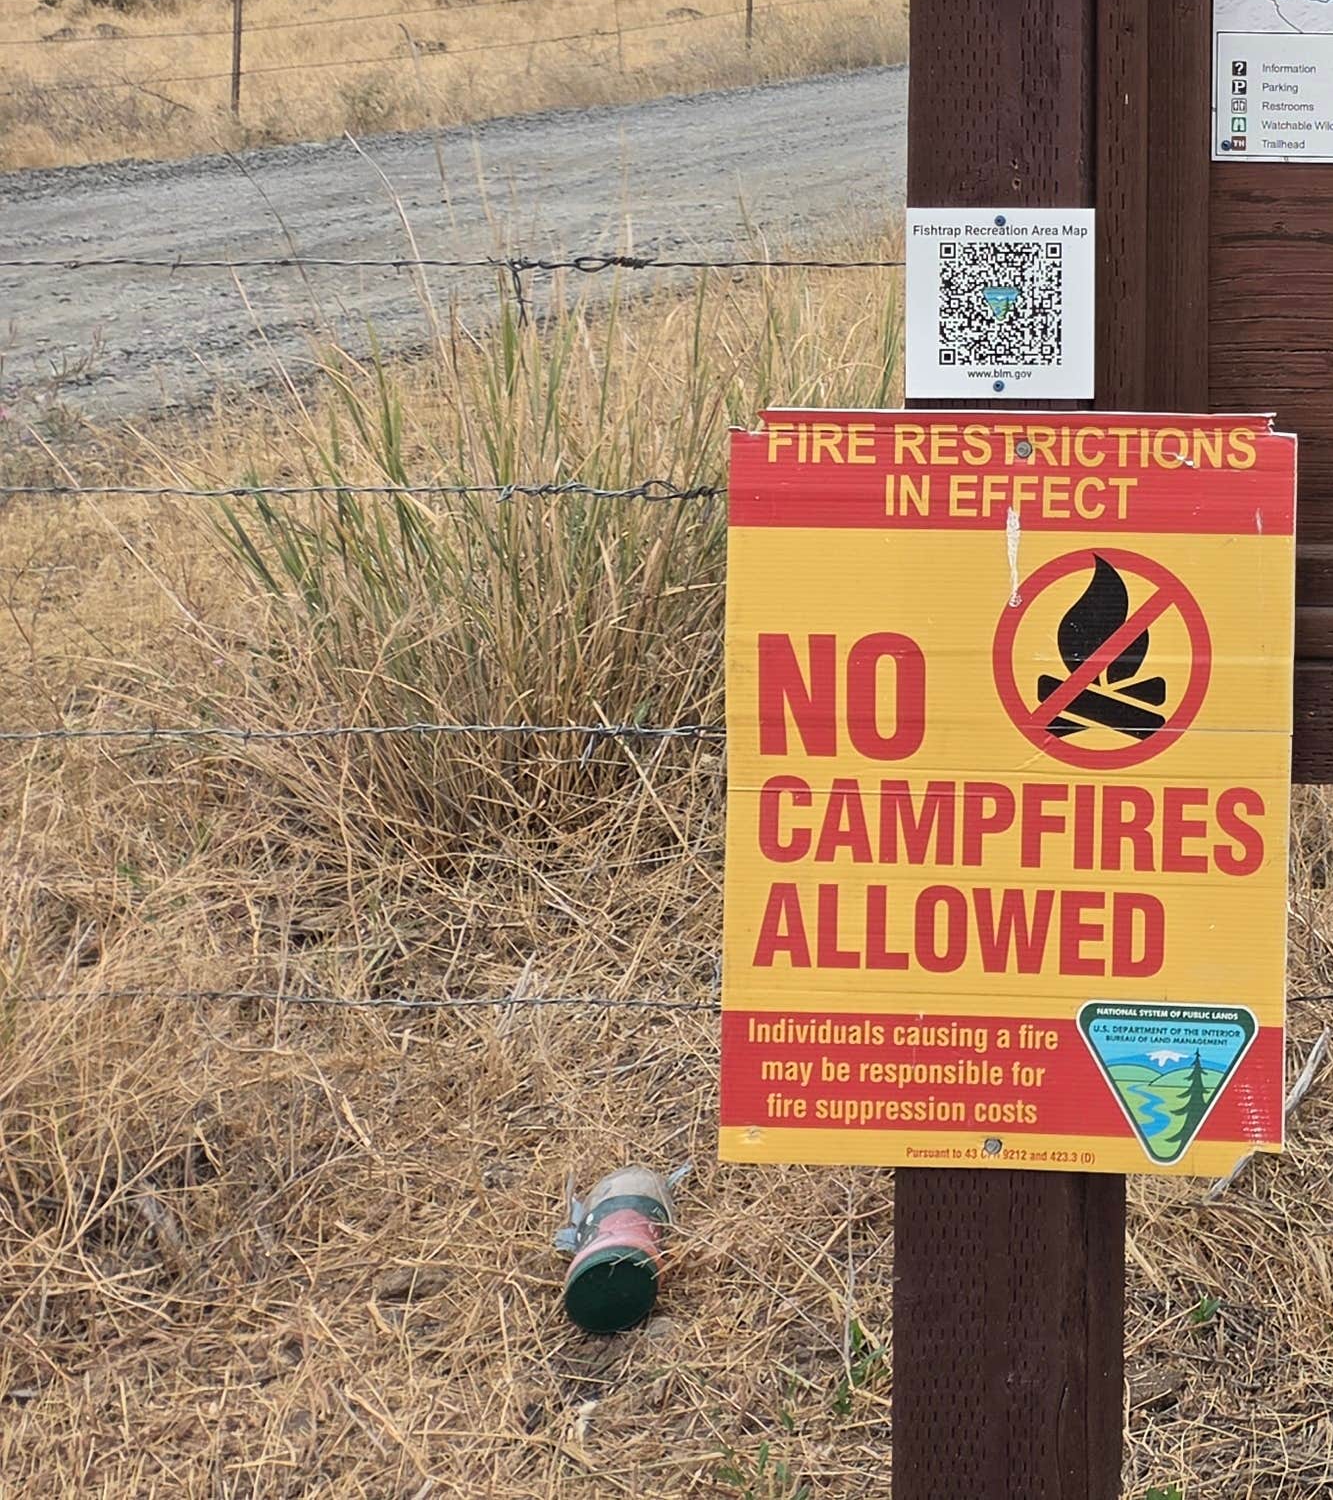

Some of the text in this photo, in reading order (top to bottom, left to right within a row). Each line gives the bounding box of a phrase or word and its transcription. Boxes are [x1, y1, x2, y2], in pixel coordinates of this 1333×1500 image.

[1262, 64, 1316, 74] Information
[1262, 83, 1298, 94] Parking
[1262, 102, 1314, 111] Restrooms
[1262, 140, 1305, 149] Trailhead
[913, 225, 1087, 238] Fishtrap Recreation Area Map
[968, 370, 1032, 379] www.blm.gov
[768, 423, 1256, 468] FIRE RESTRICTIONS
[883, 476, 1137, 520] IN EFFECT
[758, 632, 926, 760] NO
[758, 776, 1264, 877] CAMPFIRES
[753, 883, 1165, 977] ALLOWED
[748, 1017, 1058, 1053] Individuals causing a fire
[761, 1057, 1046, 1088] may be responsible for
[766, 1092, 1038, 1127] fire suppression costs
